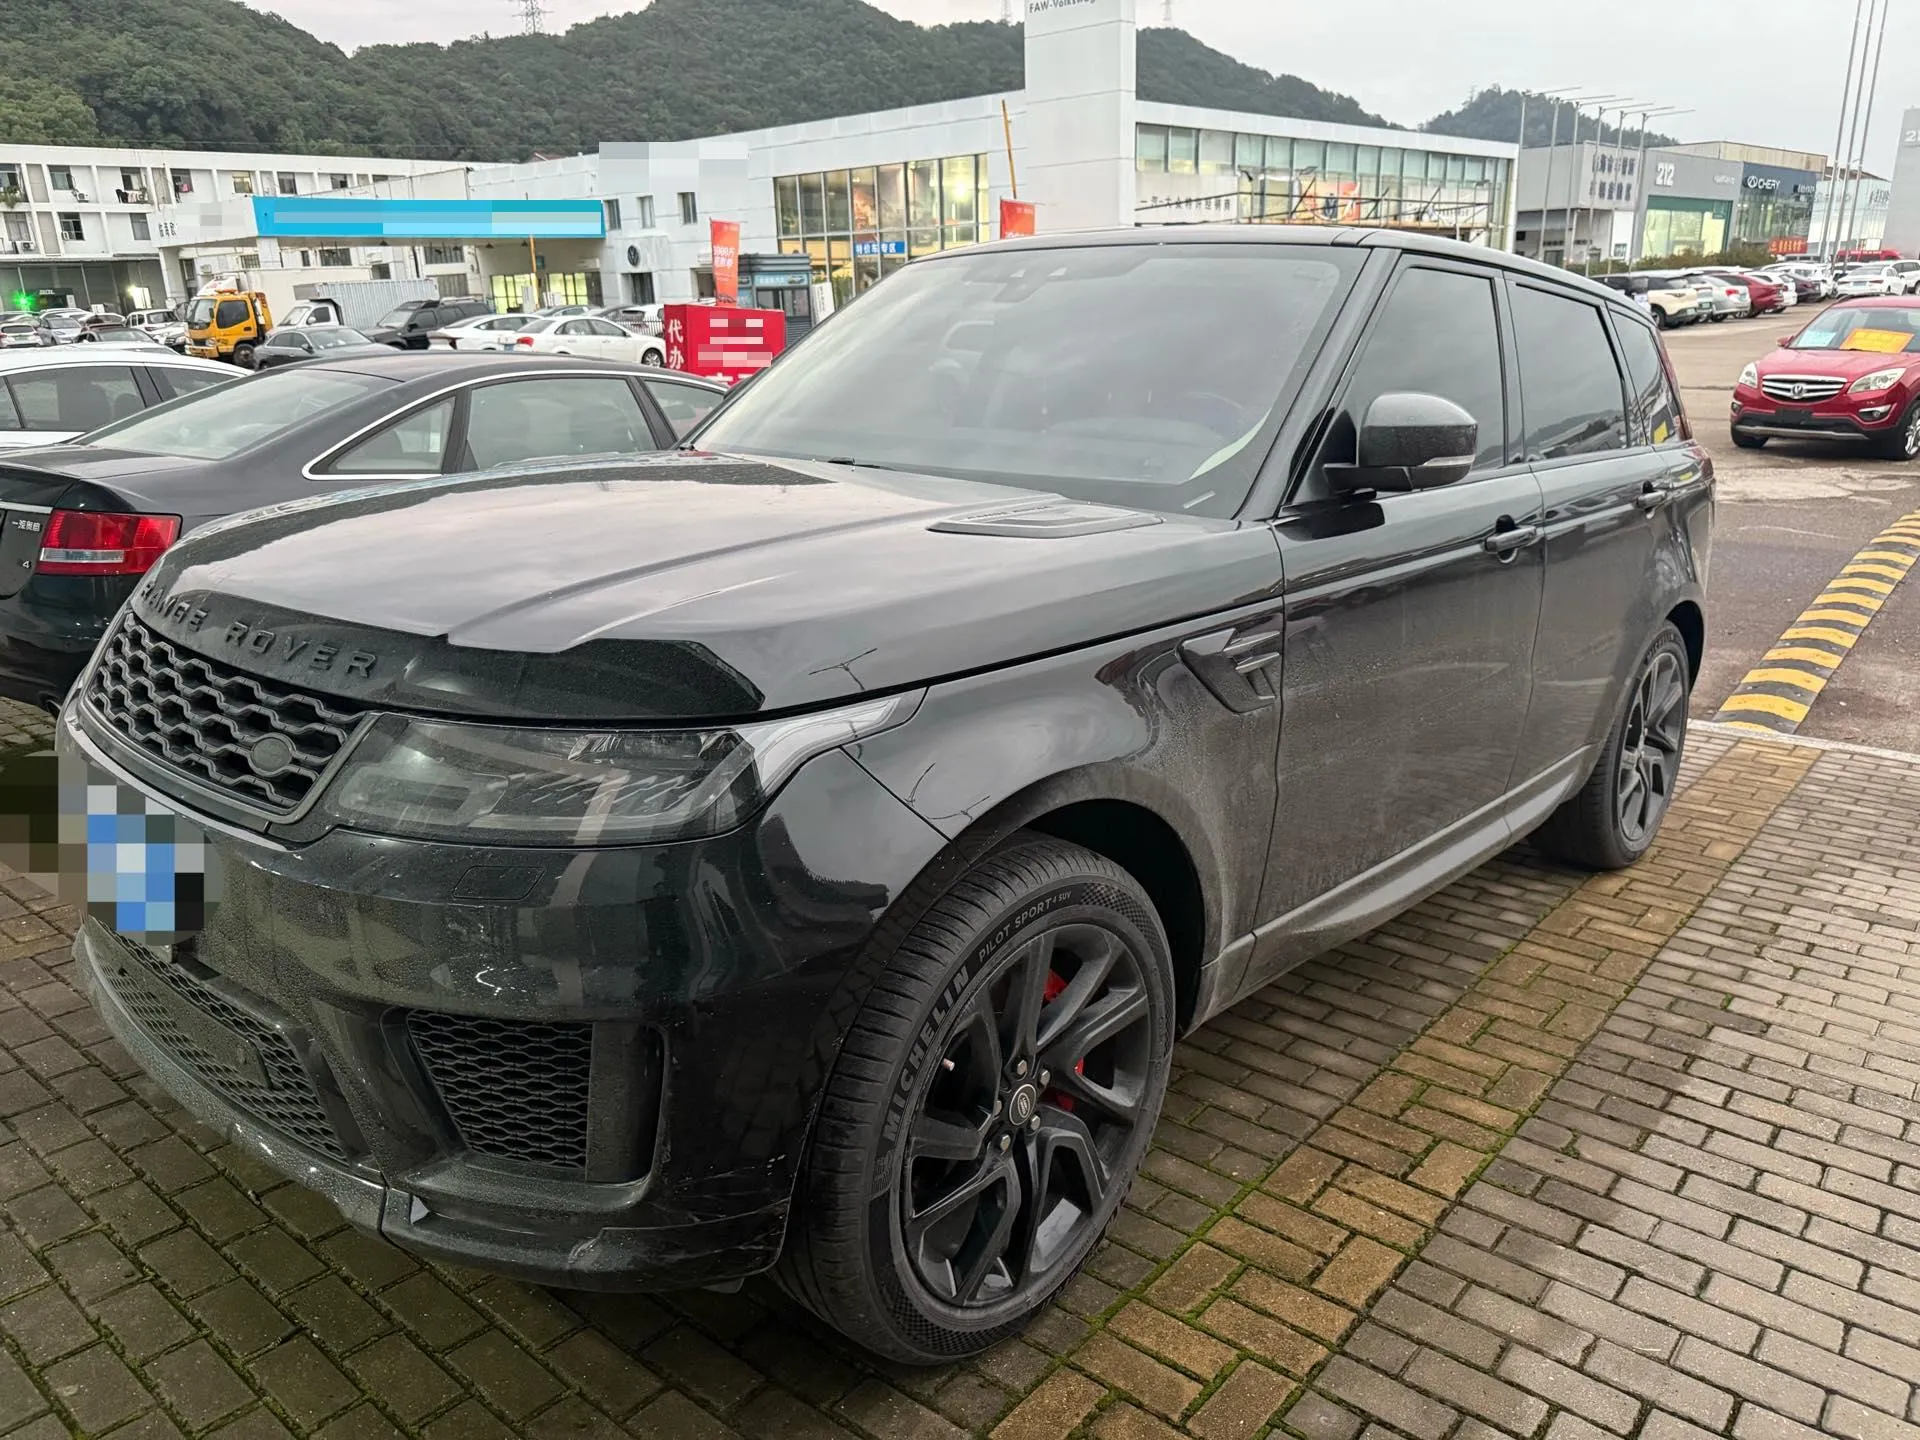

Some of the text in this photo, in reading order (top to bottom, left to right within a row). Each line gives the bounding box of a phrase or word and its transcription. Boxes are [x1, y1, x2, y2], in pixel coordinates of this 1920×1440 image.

[1656, 162, 1675, 186] 212
[1758, 179, 1780, 190] CHERY
[668, 318, 685, 370] 代办
[141, 578, 378, 679] RANGE ROVER
[882, 964, 970, 1143] MICHELIN
[979, 922, 1011, 962] PILOT
[1014, 897, 1052, 929] SPORT
[1058, 891, 1072, 902] SUV
